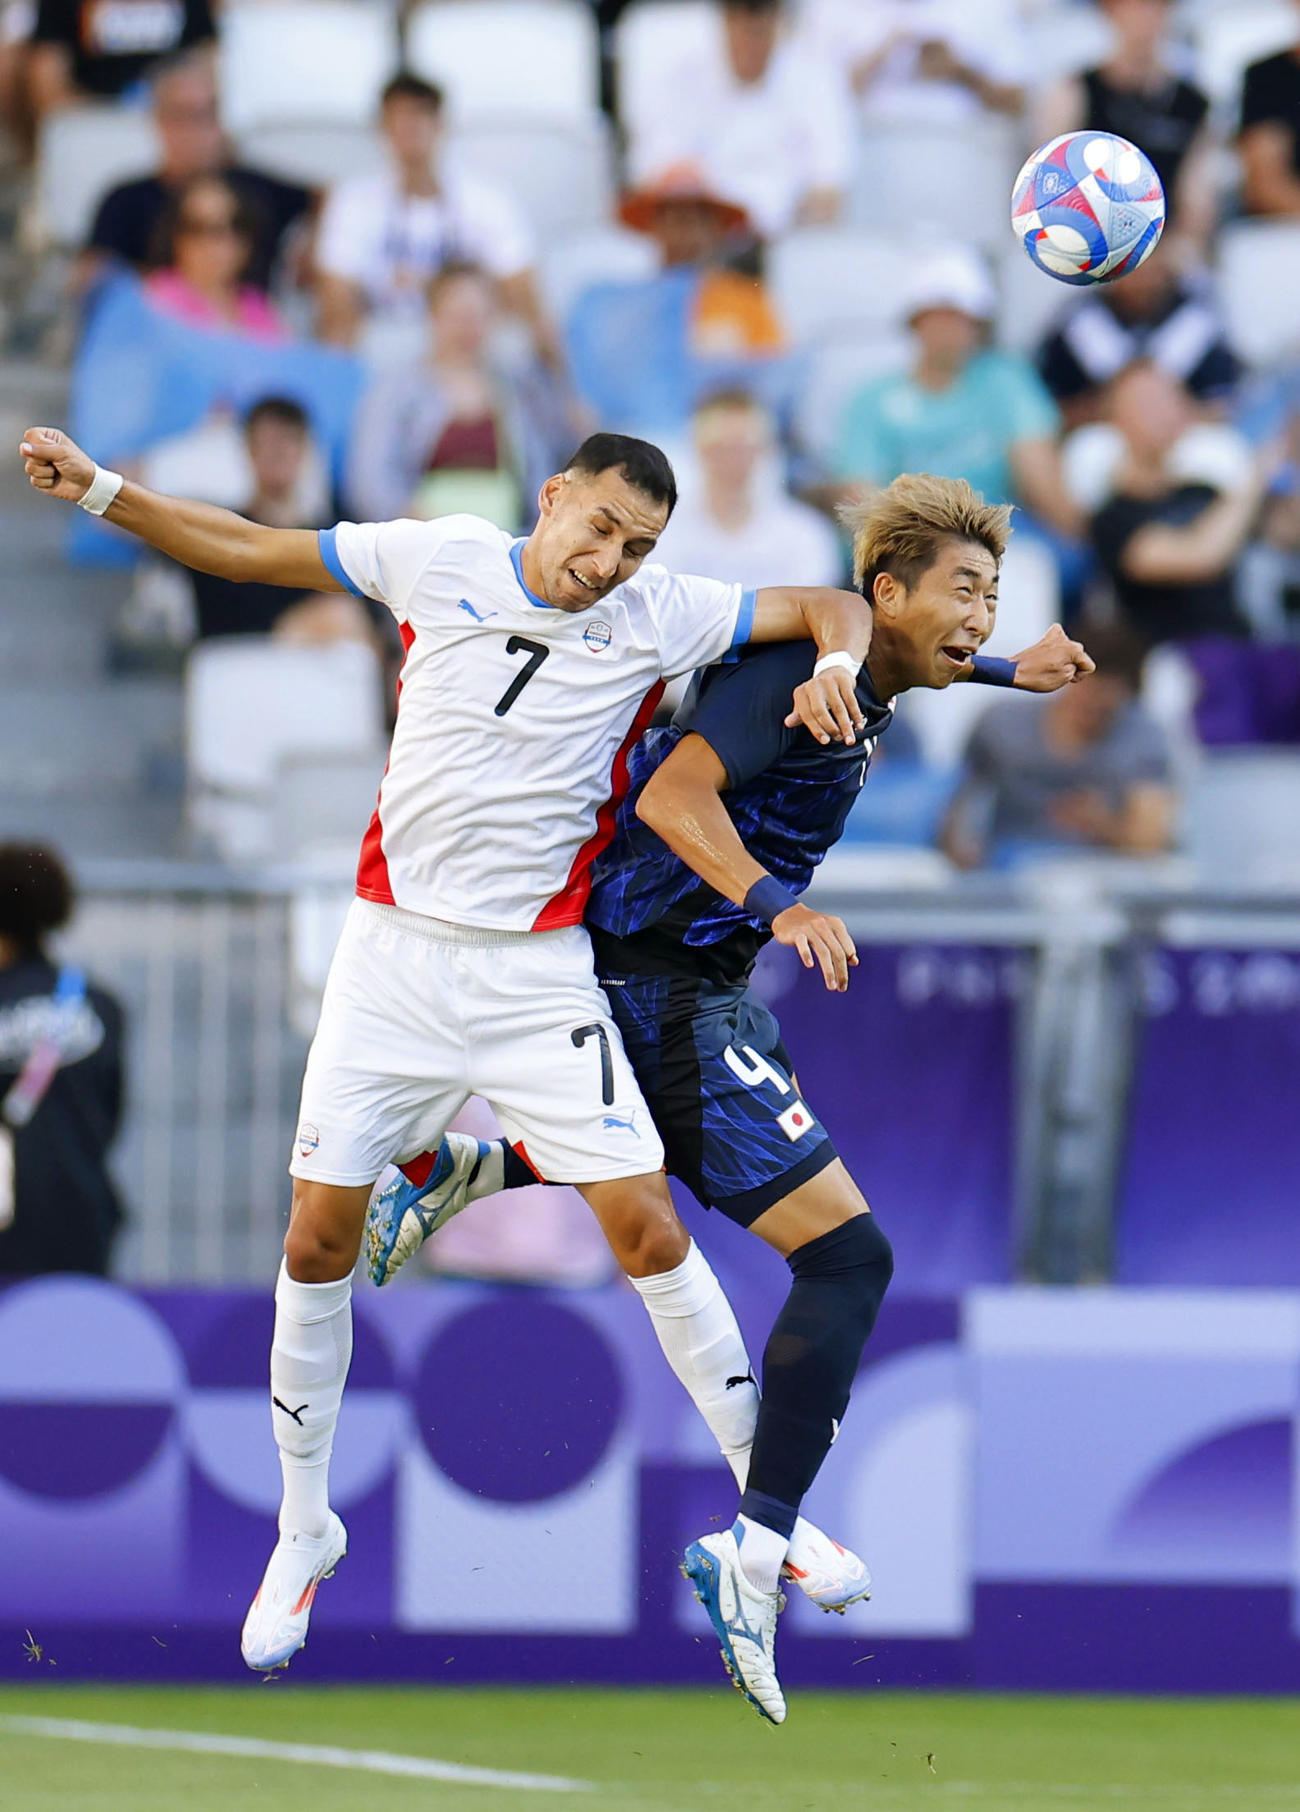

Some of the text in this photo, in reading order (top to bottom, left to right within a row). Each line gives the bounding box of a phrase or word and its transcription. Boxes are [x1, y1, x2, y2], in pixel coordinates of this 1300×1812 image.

[494, 635, 550, 717] 7
[571, 1023, 615, 1106] 7
[723, 1044, 791, 1096] 4
